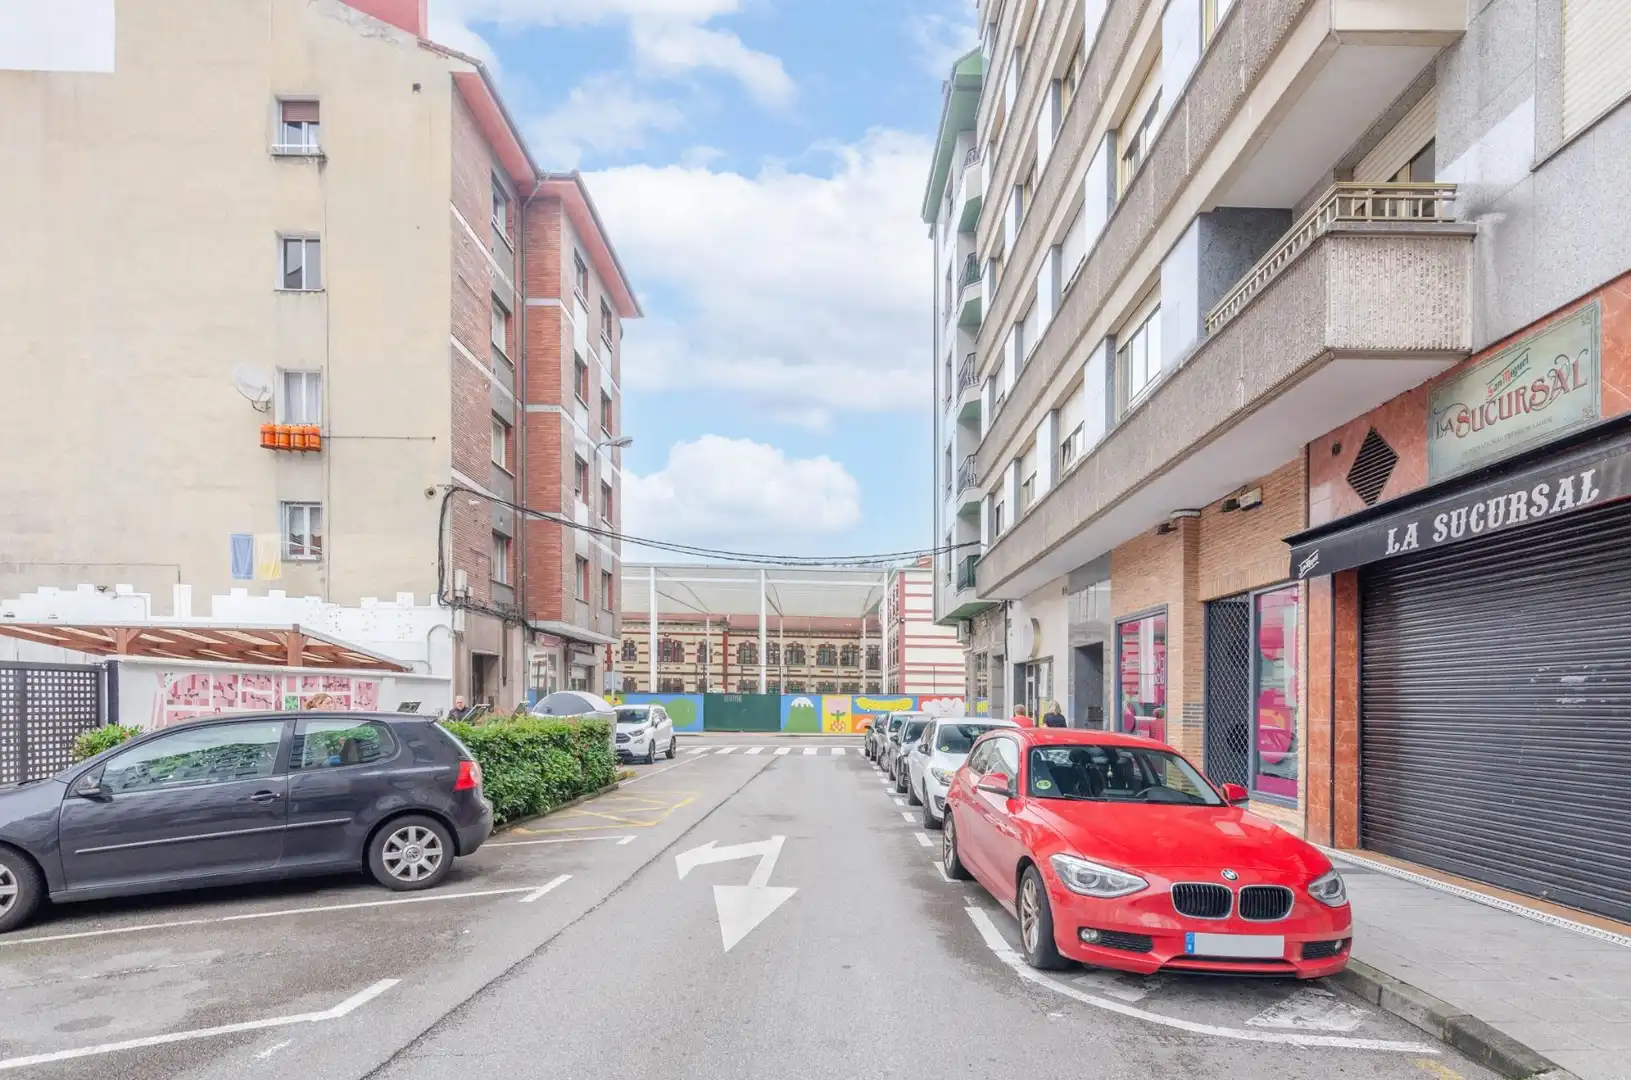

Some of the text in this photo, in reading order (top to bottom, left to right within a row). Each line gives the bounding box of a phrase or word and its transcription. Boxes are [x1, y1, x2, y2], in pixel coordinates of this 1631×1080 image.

[1433, 348, 1589, 441] LA SUCURSAL
[1486, 352, 1529, 398] San Miguel
[1385, 469, 1600, 555] LA SUCURSAL
